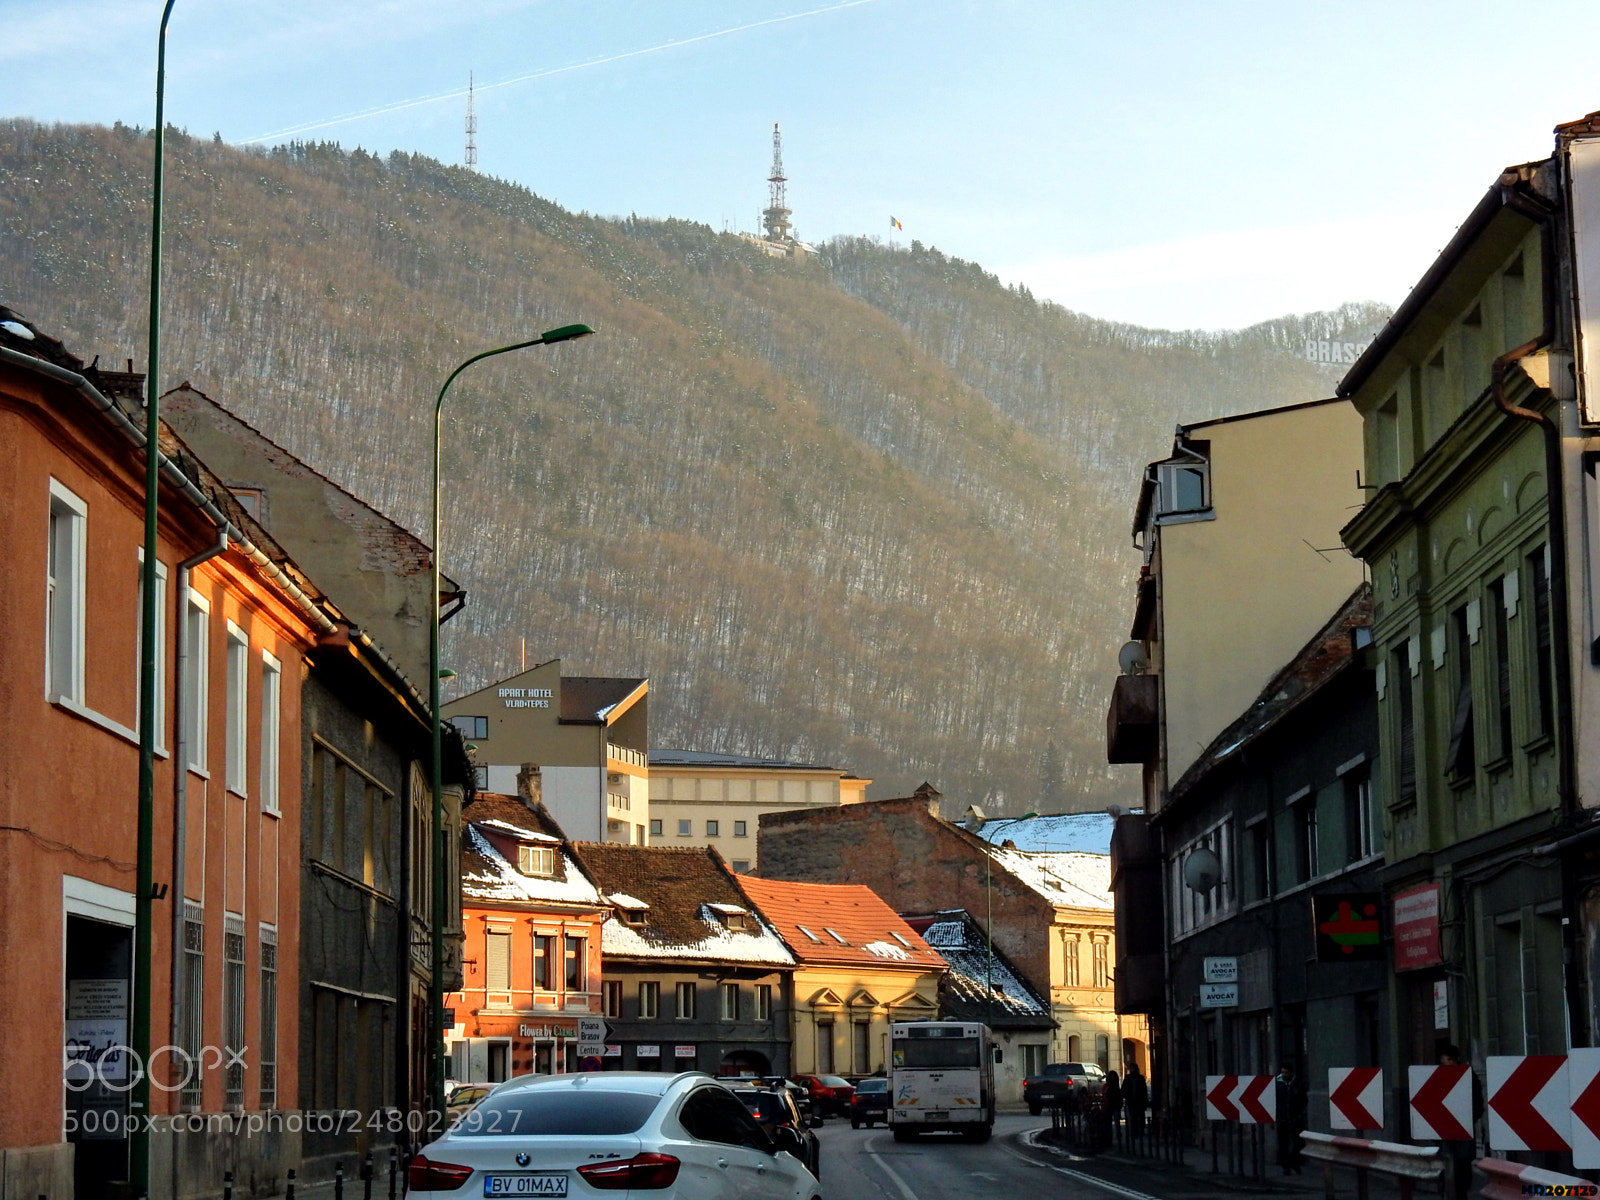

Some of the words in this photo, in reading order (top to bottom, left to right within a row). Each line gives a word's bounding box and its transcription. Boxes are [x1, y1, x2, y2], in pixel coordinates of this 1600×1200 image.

[499, 688, 525, 698] APART
[528, 688, 553, 698] HOTEL
[581, 1021, 600, 1030] Poiana
[544, 1024, 552, 1038] by
[581, 1032, 600, 1040] Brasov
[580, 1045, 599, 1055] Centru
[492, 1178, 512, 1192] BV
[517, 1178, 565, 1192] 01MAX
